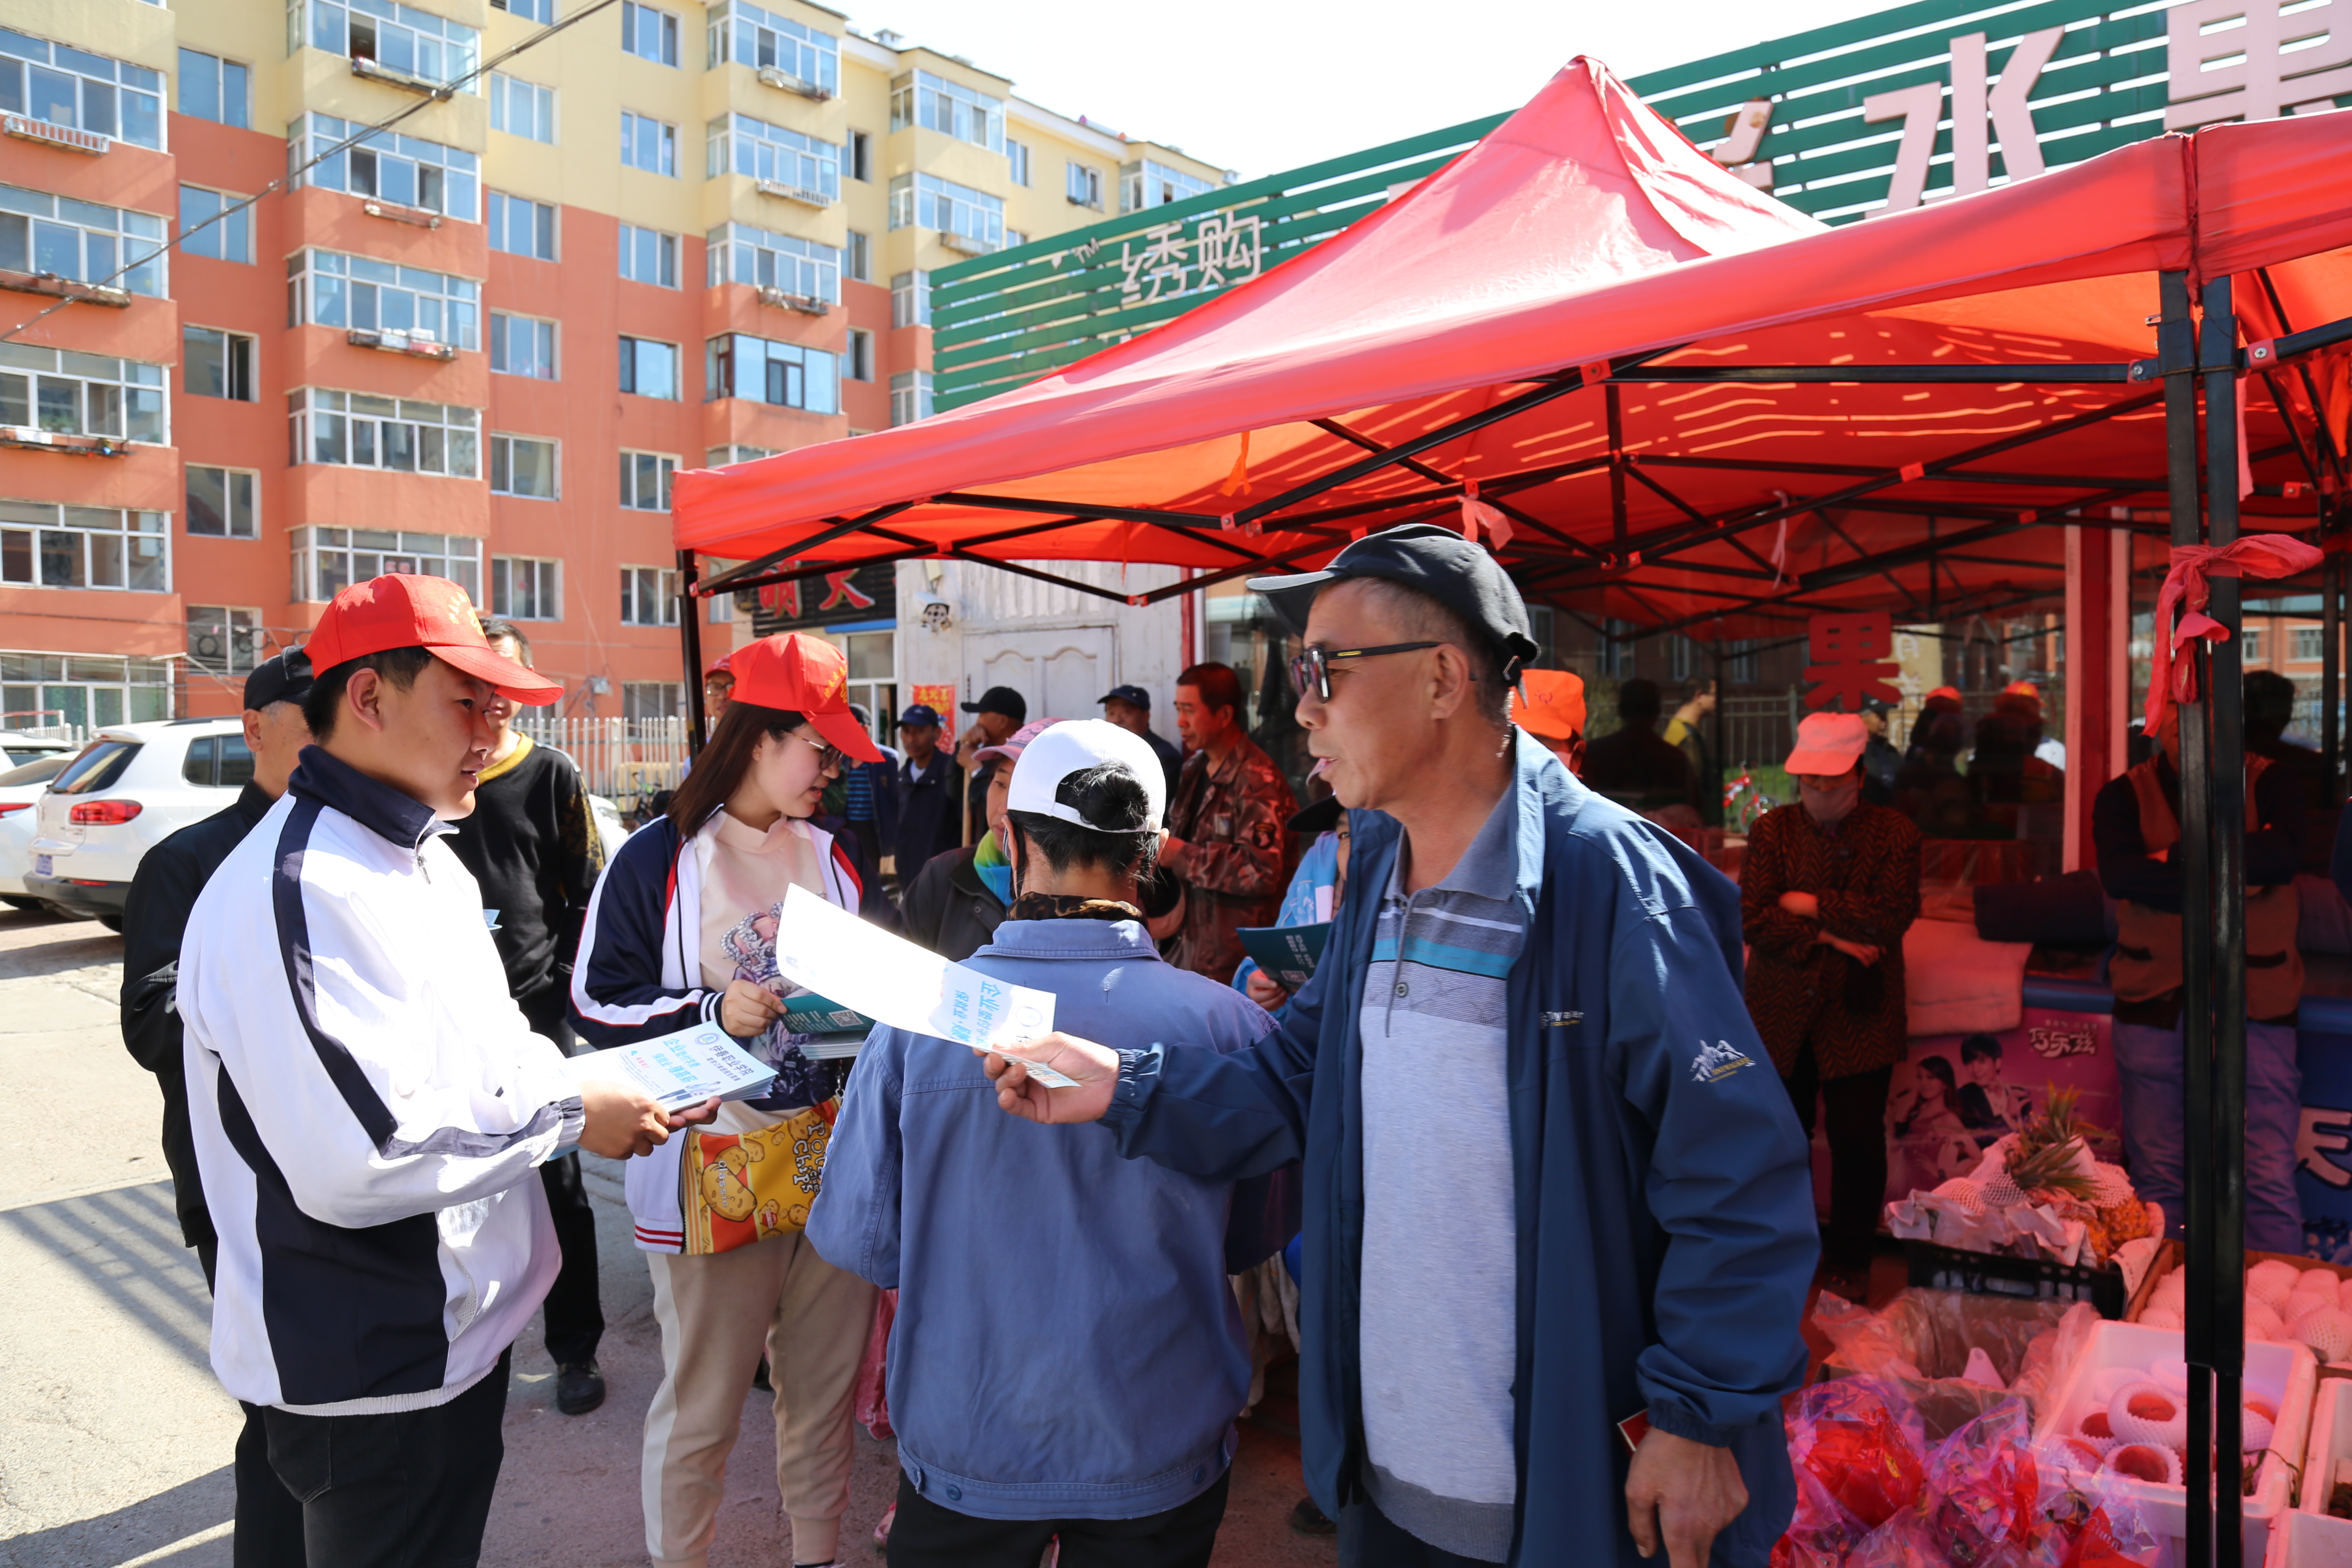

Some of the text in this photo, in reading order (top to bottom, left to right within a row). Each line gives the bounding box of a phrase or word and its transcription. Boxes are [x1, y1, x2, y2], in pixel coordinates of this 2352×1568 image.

[1074, 237, 1100, 264] TM
[1120, 210, 1262, 305] 绣购
[1804, 612, 1902, 710] 果
[2028, 1027, 2097, 1058] 巧乐兹
[709, 1045, 755, 1076] 伊春职业学院
